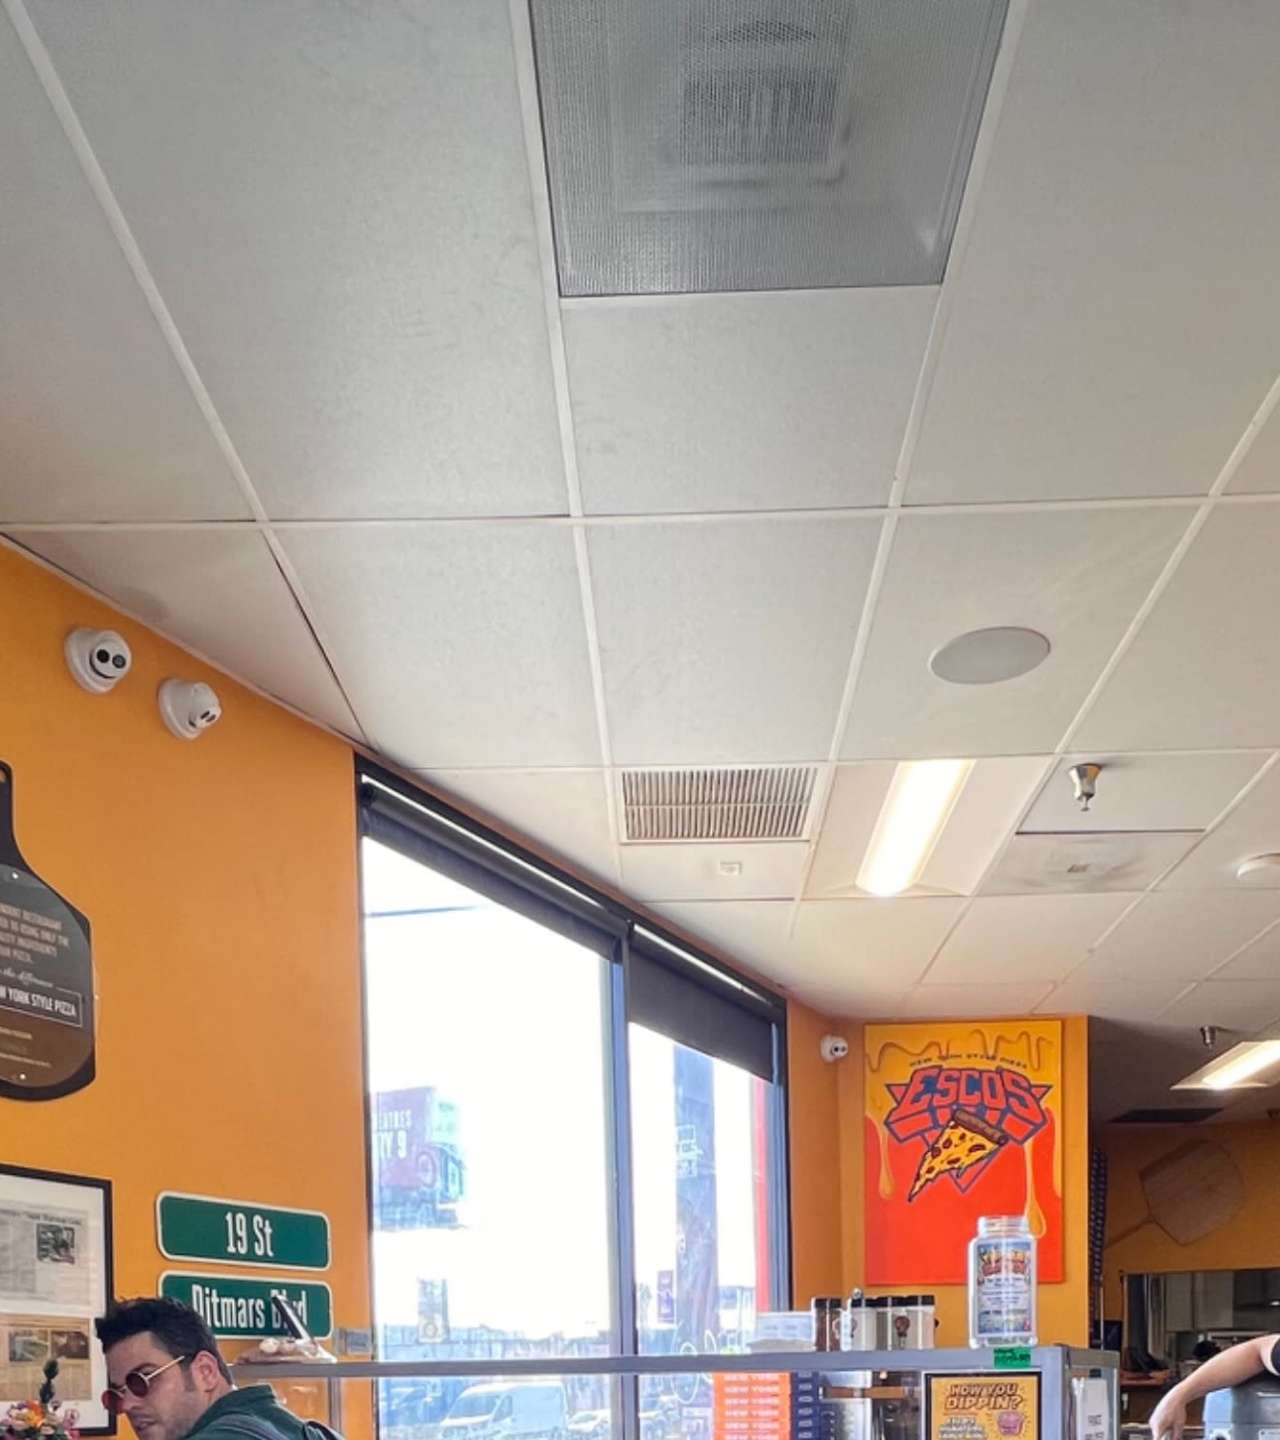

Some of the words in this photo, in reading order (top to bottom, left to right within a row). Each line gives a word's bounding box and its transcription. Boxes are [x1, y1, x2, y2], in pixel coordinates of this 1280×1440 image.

[8, 986, 30, 1005] YORK
[31, 993, 53, 1011] STYLE
[54, 999, 77, 1017] PIZZA
[225, 1211, 249, 1255] 19
[253, 1217, 275, 1258] St
[191, 1284, 266, 1329] Ditmars
